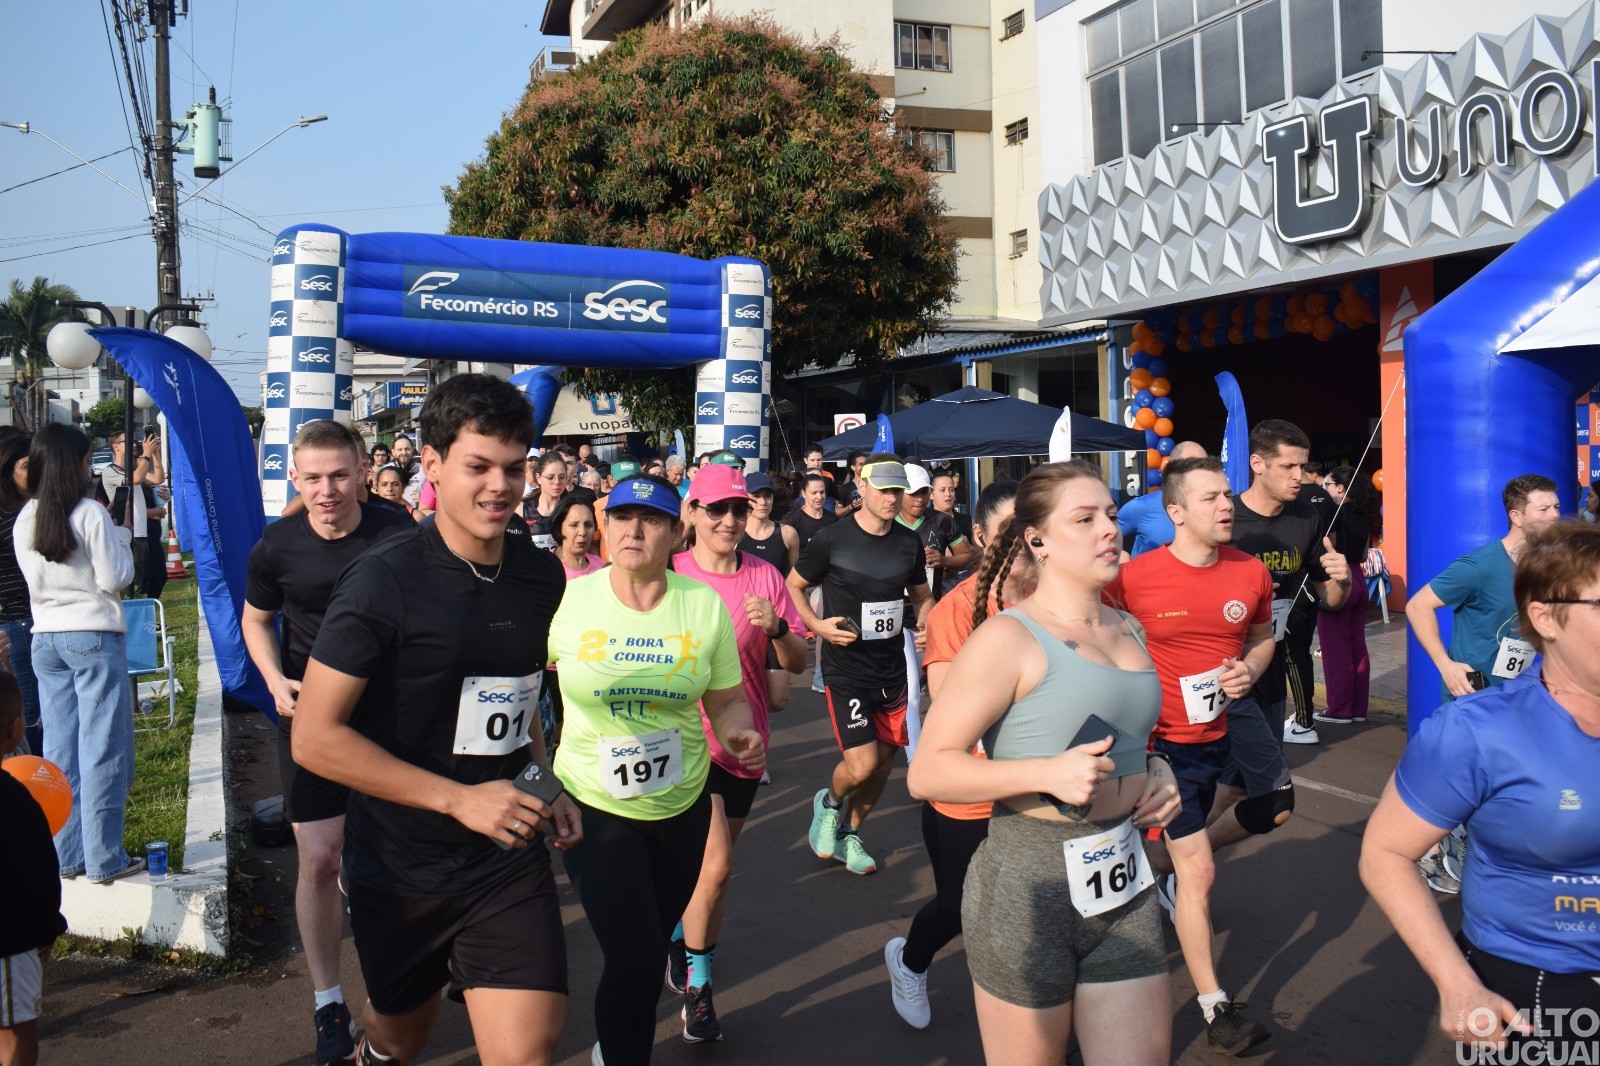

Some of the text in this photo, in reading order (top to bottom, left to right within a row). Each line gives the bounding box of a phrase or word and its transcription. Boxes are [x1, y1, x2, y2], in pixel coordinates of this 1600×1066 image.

[1395, 61, 1600, 187] uno
[300, 279, 333, 291] Sesc
[420, 293, 559, 318] Fecomércio RS
[582, 292, 667, 323] Sesc
[735, 308, 760, 319] Sesc
[298, 351, 330, 363] Sesc
[731, 373, 759, 384] Sesc
[698, 406, 719, 416] Sesc
[729, 439, 756, 449] Sesc
[205, 478, 217, 518] Comércio
[875, 617, 894, 633] 88
[625, 637, 663, 648] BORA
[613, 651, 674, 664] CORRER
[1506, 657, 1525, 673] 81
[1192, 679, 1215, 692] Sesc
[477, 690, 515, 703] Sesc
[608, 687, 688, 701] ANIVERSÁRIO
[849, 698, 862, 720] 2
[486, 709, 525, 741] 01
[611, 745, 641, 758] Sesc
[613, 754, 670, 786] 197
[1082, 845, 1116, 864] Sesc
[1086, 852, 1137, 899] 160
[1554, 920, 1597, 932] Você é
